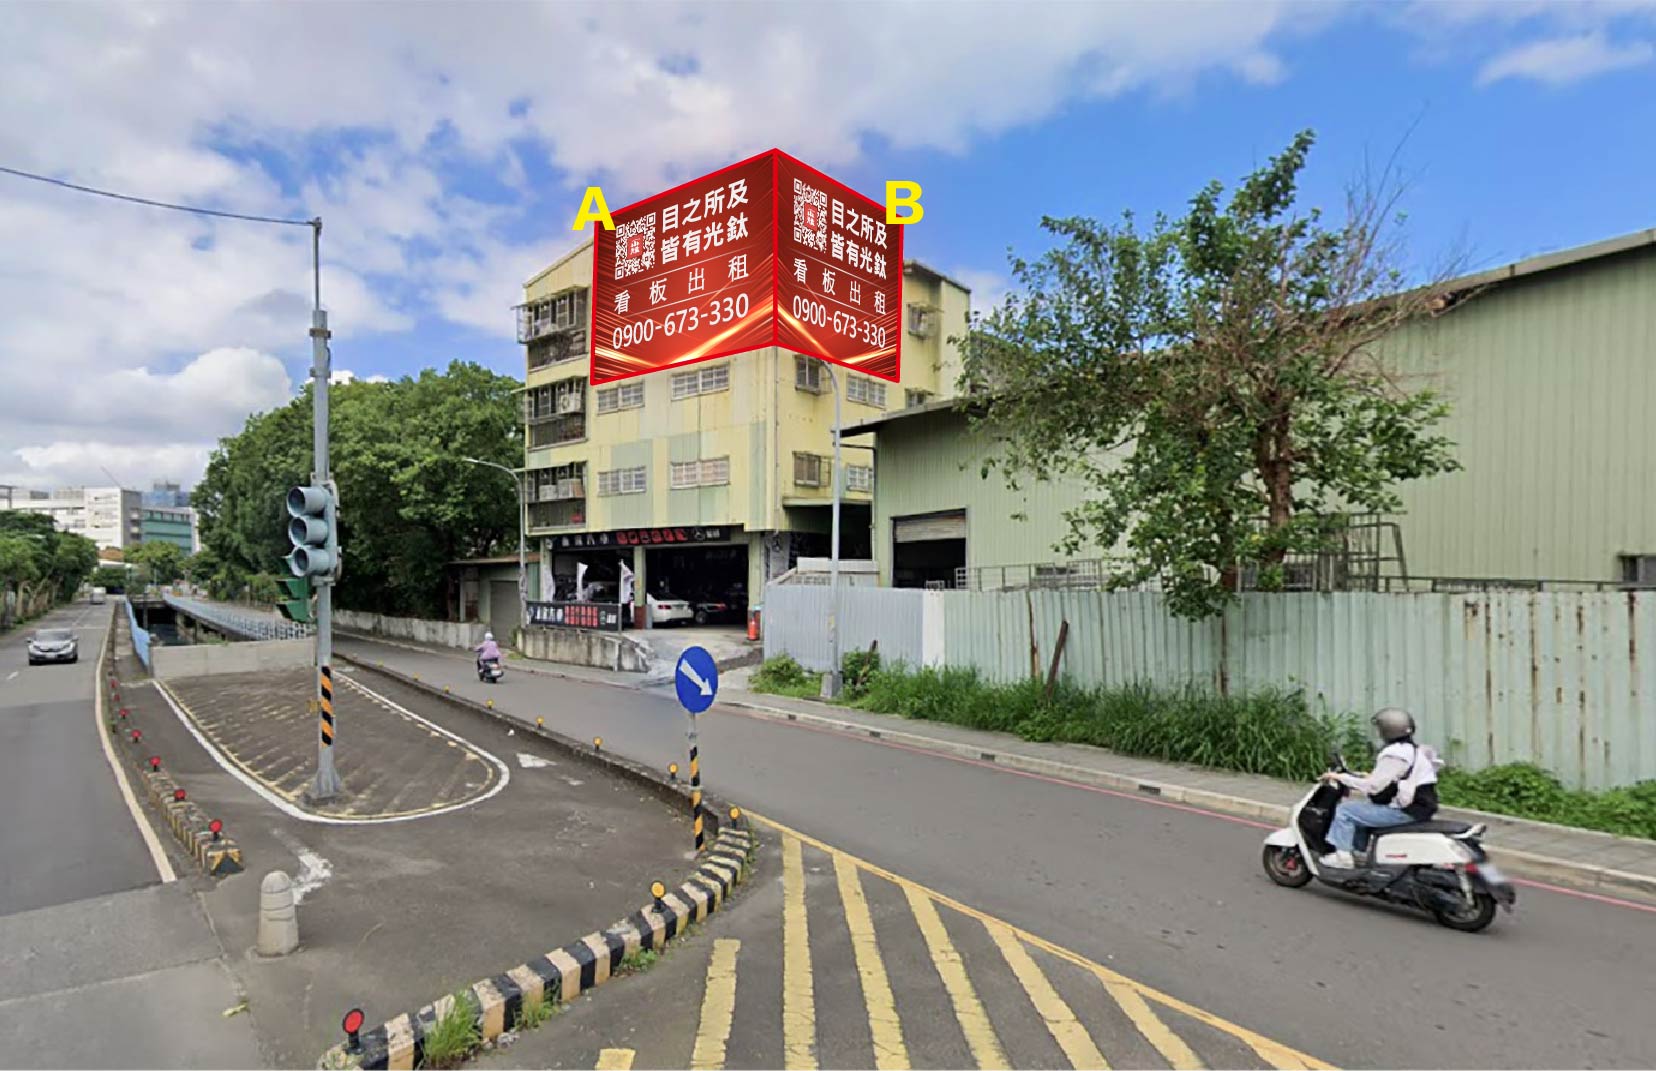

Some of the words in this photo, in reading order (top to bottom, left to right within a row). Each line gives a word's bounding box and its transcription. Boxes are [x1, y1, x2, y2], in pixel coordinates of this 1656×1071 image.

[662, 178, 749, 233] 目之所及
[831, 199, 888, 249] 目之所及
[660, 211, 749, 264] 皆有光鈦
[830, 231, 887, 280] 皆有光鈦
[614, 254, 749, 315] 看板出租
[793, 258, 887, 316] 看板出租
[612, 293, 749, 350] 0900-673-330
[793, 295, 886, 348] 0900-673-330
